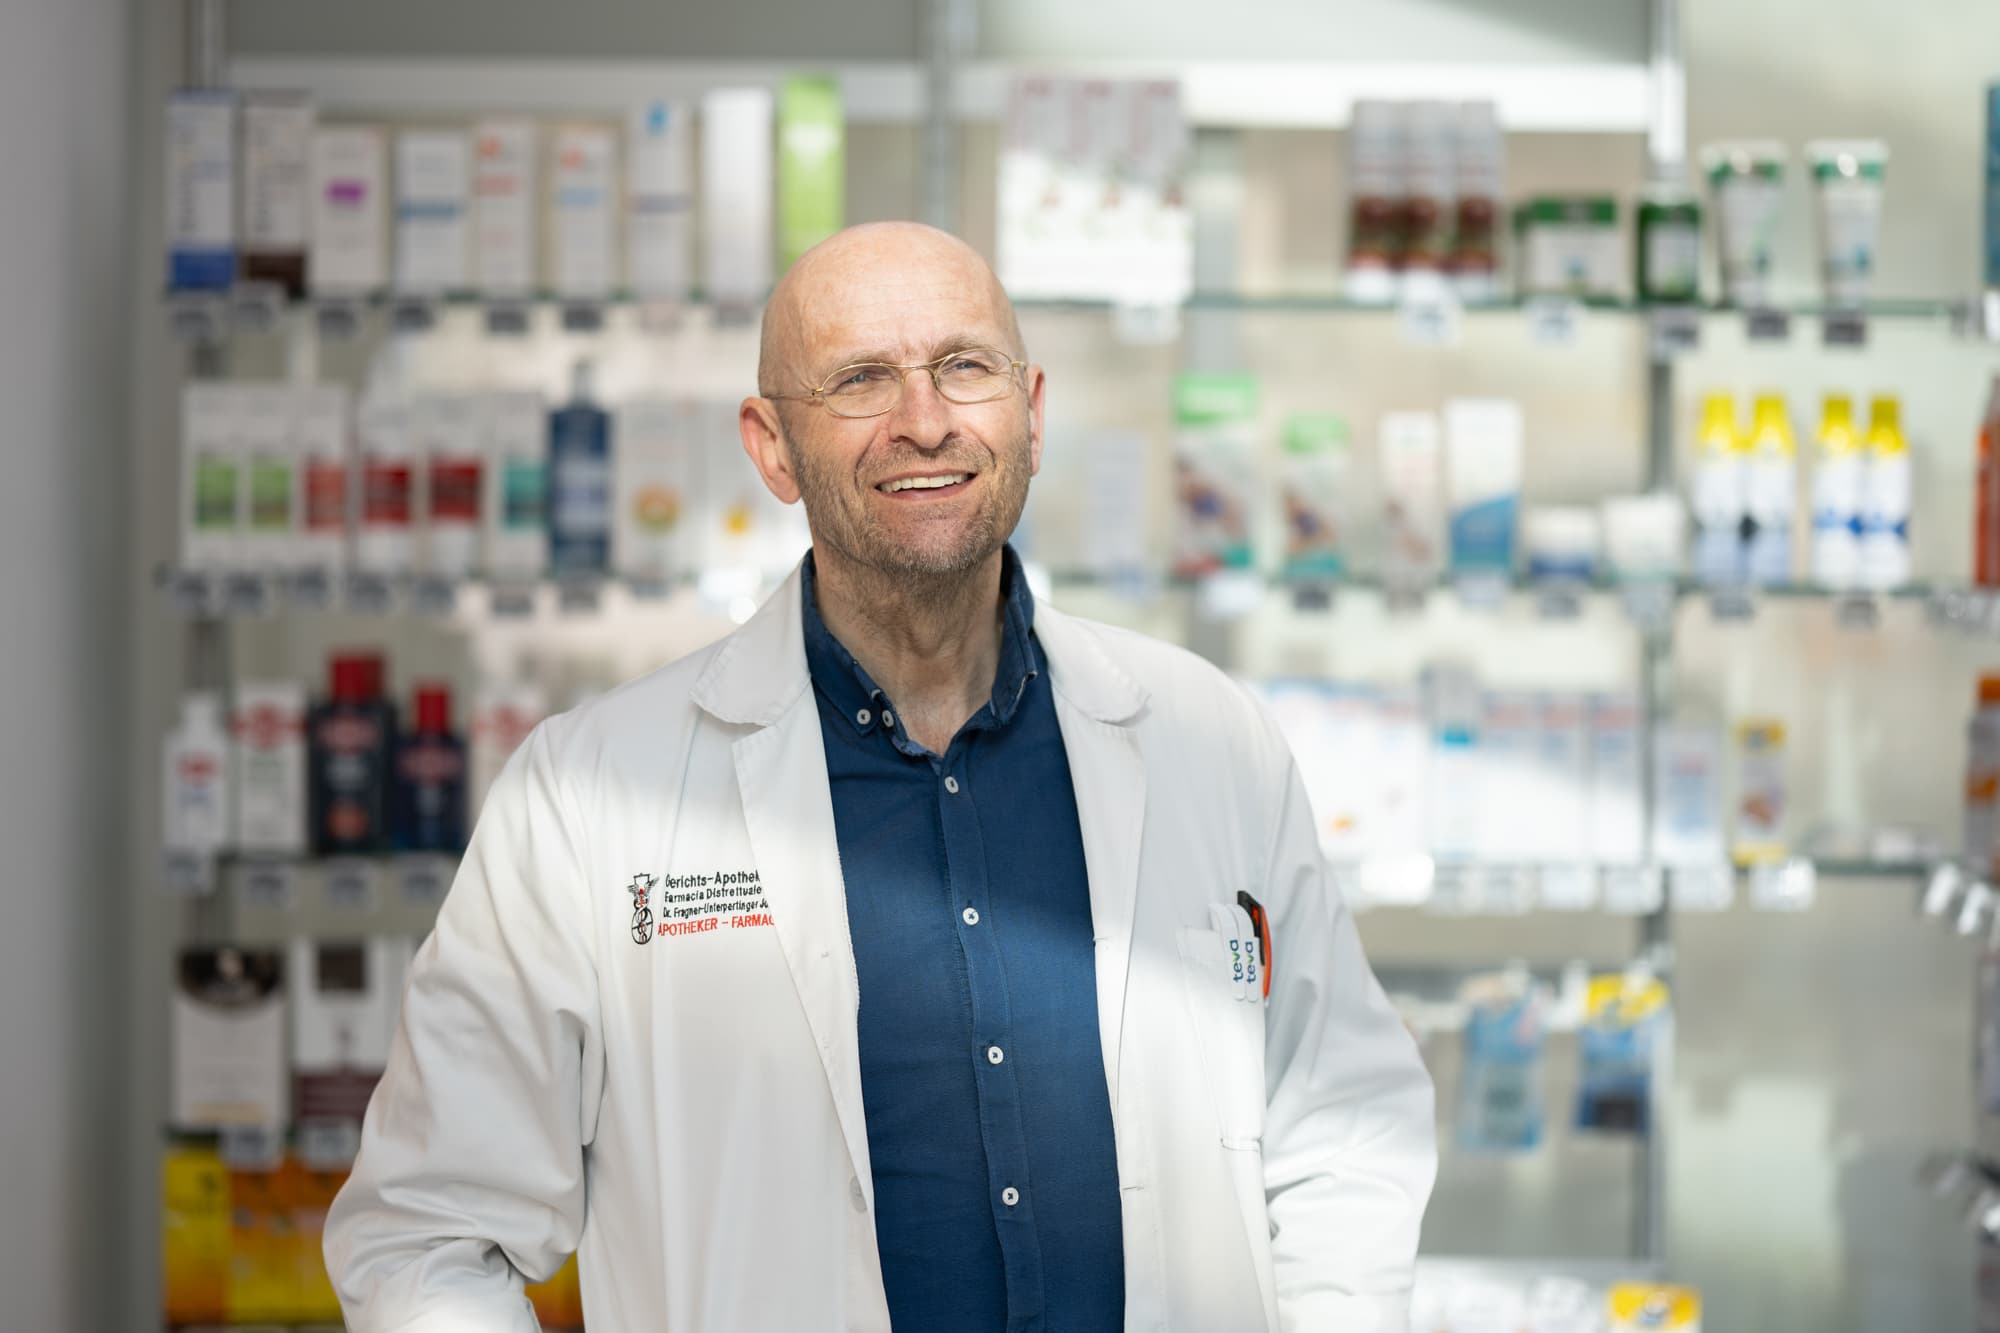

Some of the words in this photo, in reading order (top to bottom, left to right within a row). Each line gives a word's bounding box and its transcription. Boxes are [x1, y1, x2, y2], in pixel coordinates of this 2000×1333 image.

[664, 890, 705, 903] Farmacia
[706, 884, 762, 899] Distrettuale
[663, 906, 672, 918] Dr.
[673, 900, 758, 920] Fragner-Unterpertinger
[657, 916, 718, 937] APOTHEKER
[1229, 939, 1244, 982] teva
[1245, 941, 1256, 984] teva
